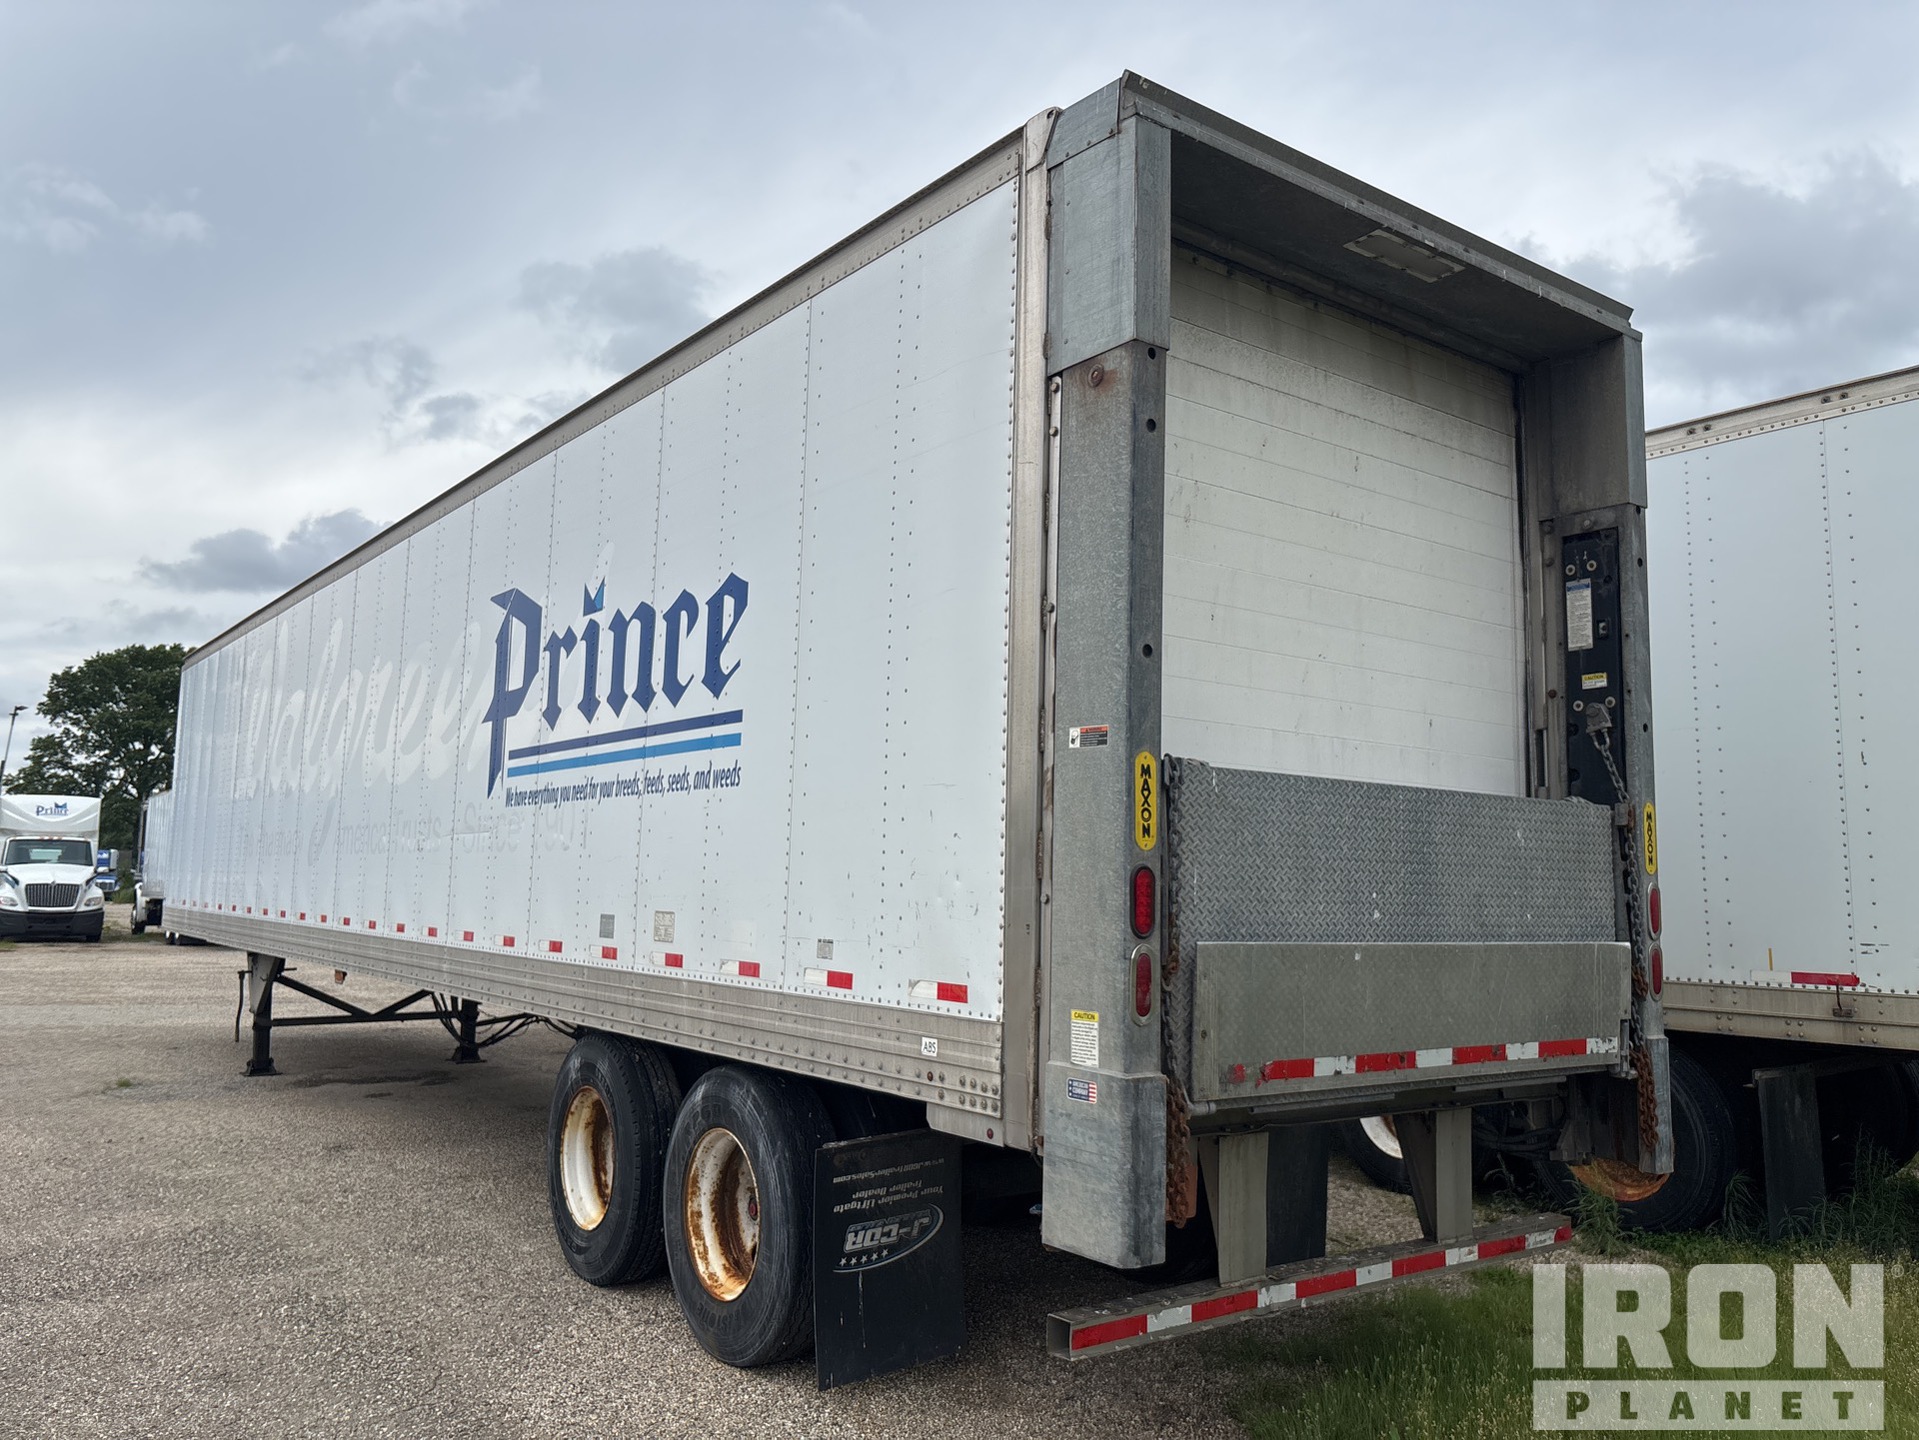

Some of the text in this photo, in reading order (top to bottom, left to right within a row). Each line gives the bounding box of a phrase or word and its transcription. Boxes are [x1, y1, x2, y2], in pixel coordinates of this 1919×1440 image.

[481, 572, 749, 799] Prince
[506, 759, 741, 810] We have everything you need for your breeds, feeds, seeds, and weeds
[1140, 763, 1152, 839] MAXON
[1646, 811, 1654, 866] MAXON
[1074, 1011, 1095, 1020] CAUTION
[922, 1041, 937, 1054] ABS
[833, 1186, 944, 1213] Your Premier Liftgate
[852, 1180, 922, 1199] Trailer Dealer
[845, 1216, 930, 1251] J-COR
